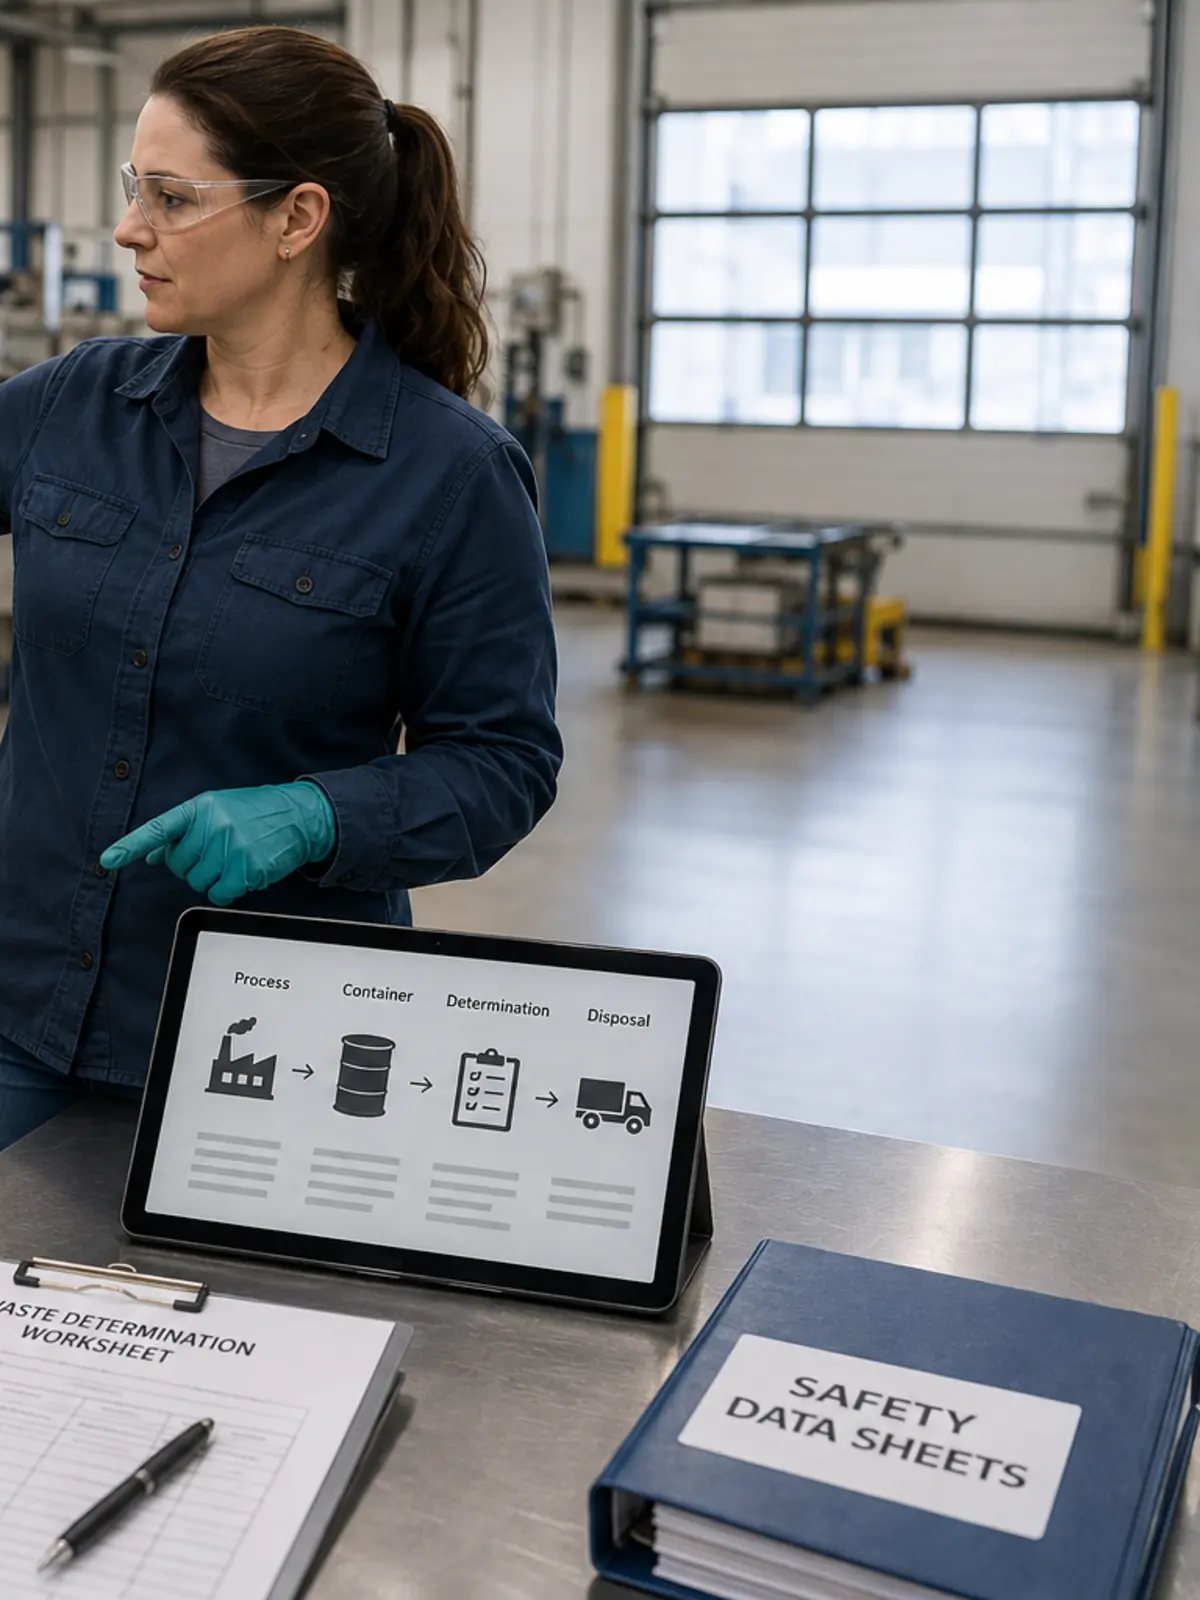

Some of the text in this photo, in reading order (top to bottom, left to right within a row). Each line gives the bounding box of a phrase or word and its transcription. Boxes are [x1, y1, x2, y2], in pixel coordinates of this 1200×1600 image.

[234, 971, 290, 991] Process
[342, 983, 414, 1003] Container
[446, 993, 550, 1018] Determination
[587, 1008, 651, 1028] Disposal
[19, 1323, 176, 1365] WORKSHEET
[60, 1311, 257, 1358] DETERMINATION
[788, 1375, 978, 1435] SAFETY
[724, 1395, 1029, 1490] DATA SHEETS
